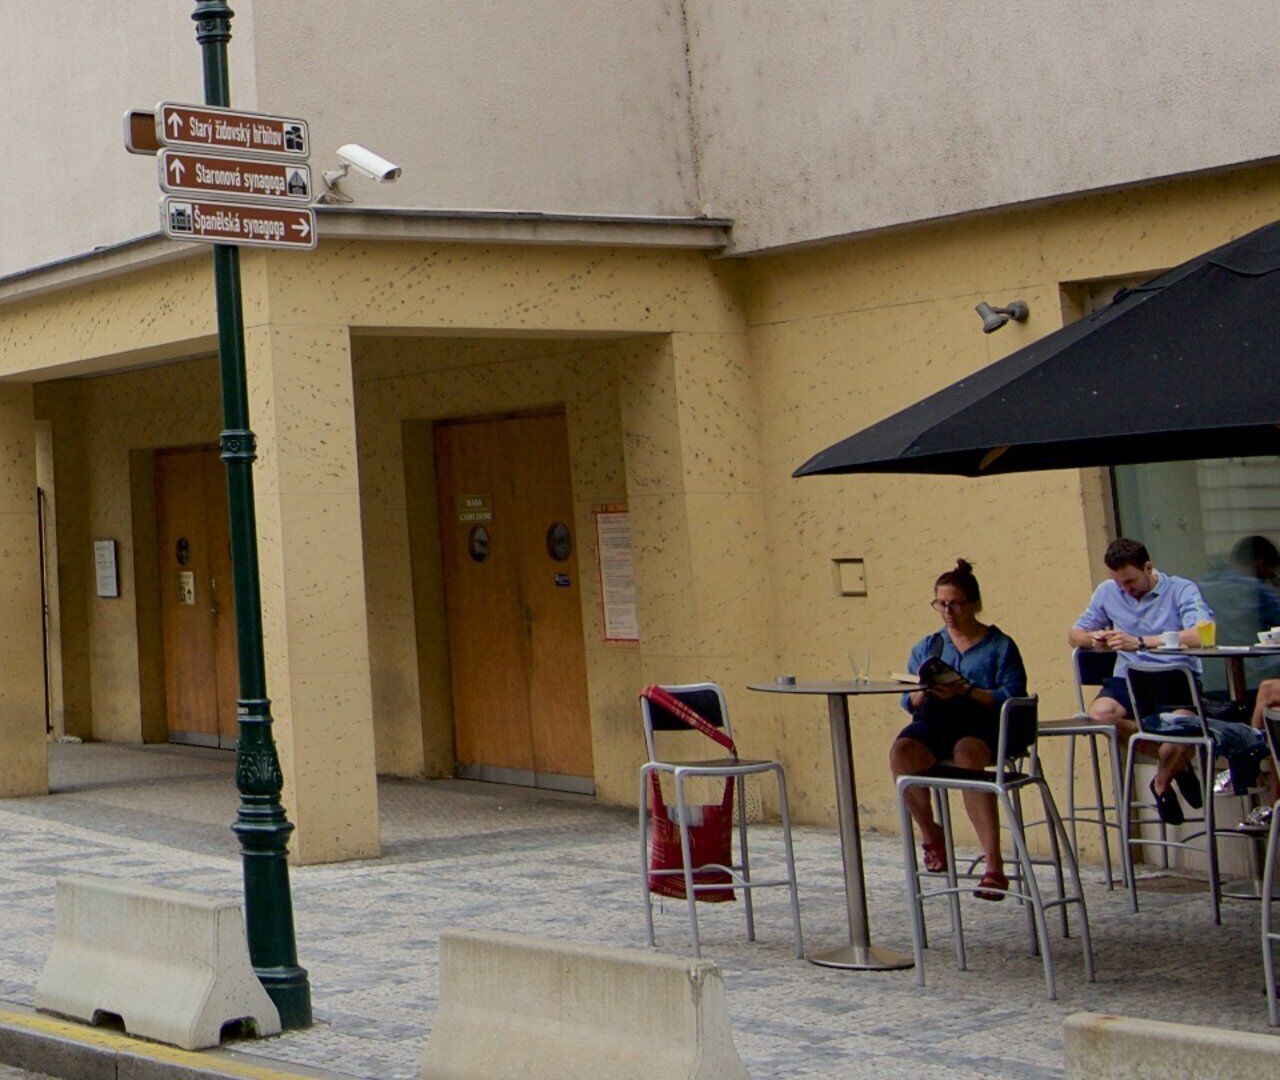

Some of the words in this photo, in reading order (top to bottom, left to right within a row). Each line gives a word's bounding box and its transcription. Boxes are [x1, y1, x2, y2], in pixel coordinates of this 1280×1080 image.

[189, 116, 213, 143] Starý
[215, 119, 251, 147] židovský
[253, 123, 282, 146] hřbitov
[195, 162, 241, 186] Staronová
[243, 172, 286, 195] synagoga
[193, 204, 241, 235] Španělská
[243, 217, 285, 240] synagoga
